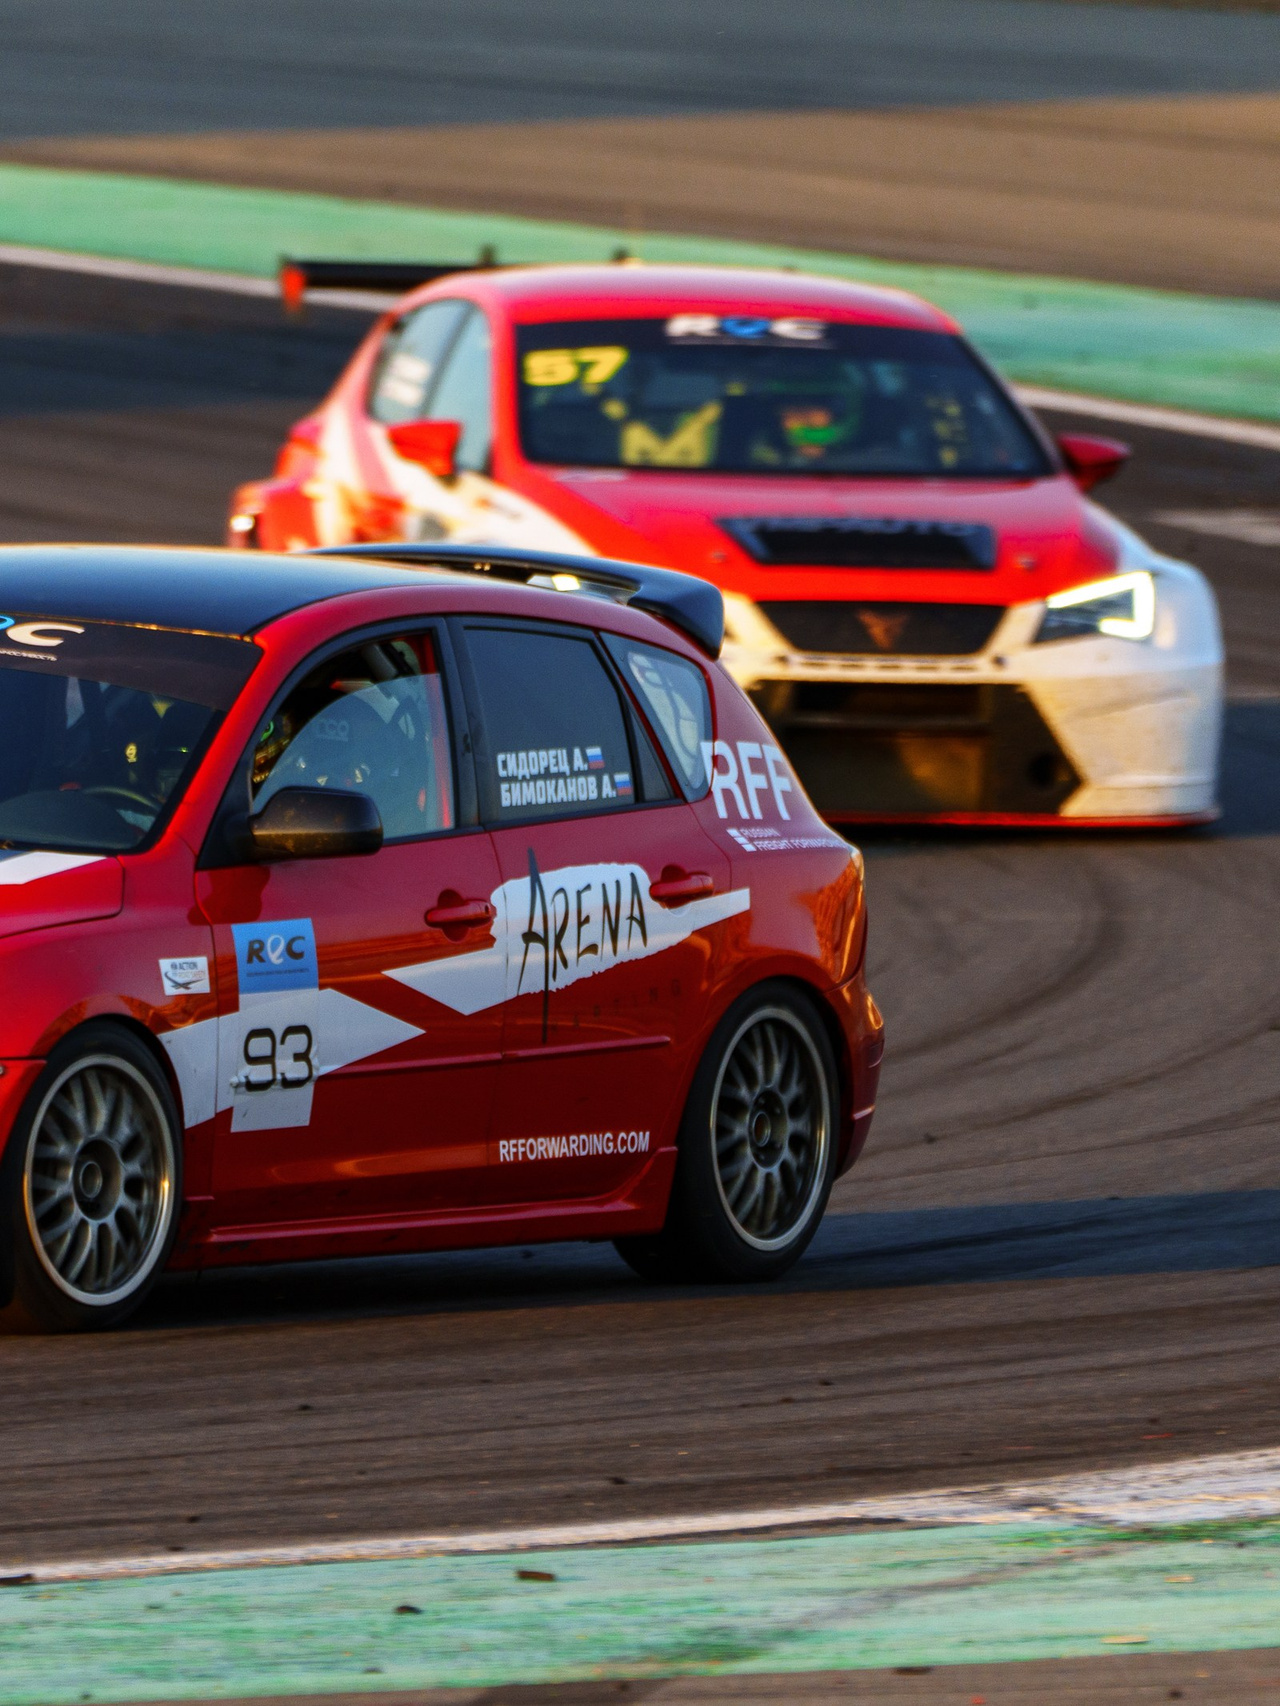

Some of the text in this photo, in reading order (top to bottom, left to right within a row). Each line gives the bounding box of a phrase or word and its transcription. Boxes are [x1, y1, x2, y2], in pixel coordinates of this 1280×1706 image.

[524, 346, 628, 385] 57
[497, 747, 588, 780] СИДОРЕЦ А.
[700, 741, 792, 820] RFF
[501, 773, 617, 807] БИМОКАНОВ А.
[517, 847, 648, 1045] ARENA
[243, 1025, 313, 1092] 93
[499, 1130, 650, 1163] RFFORWARDING.COM
